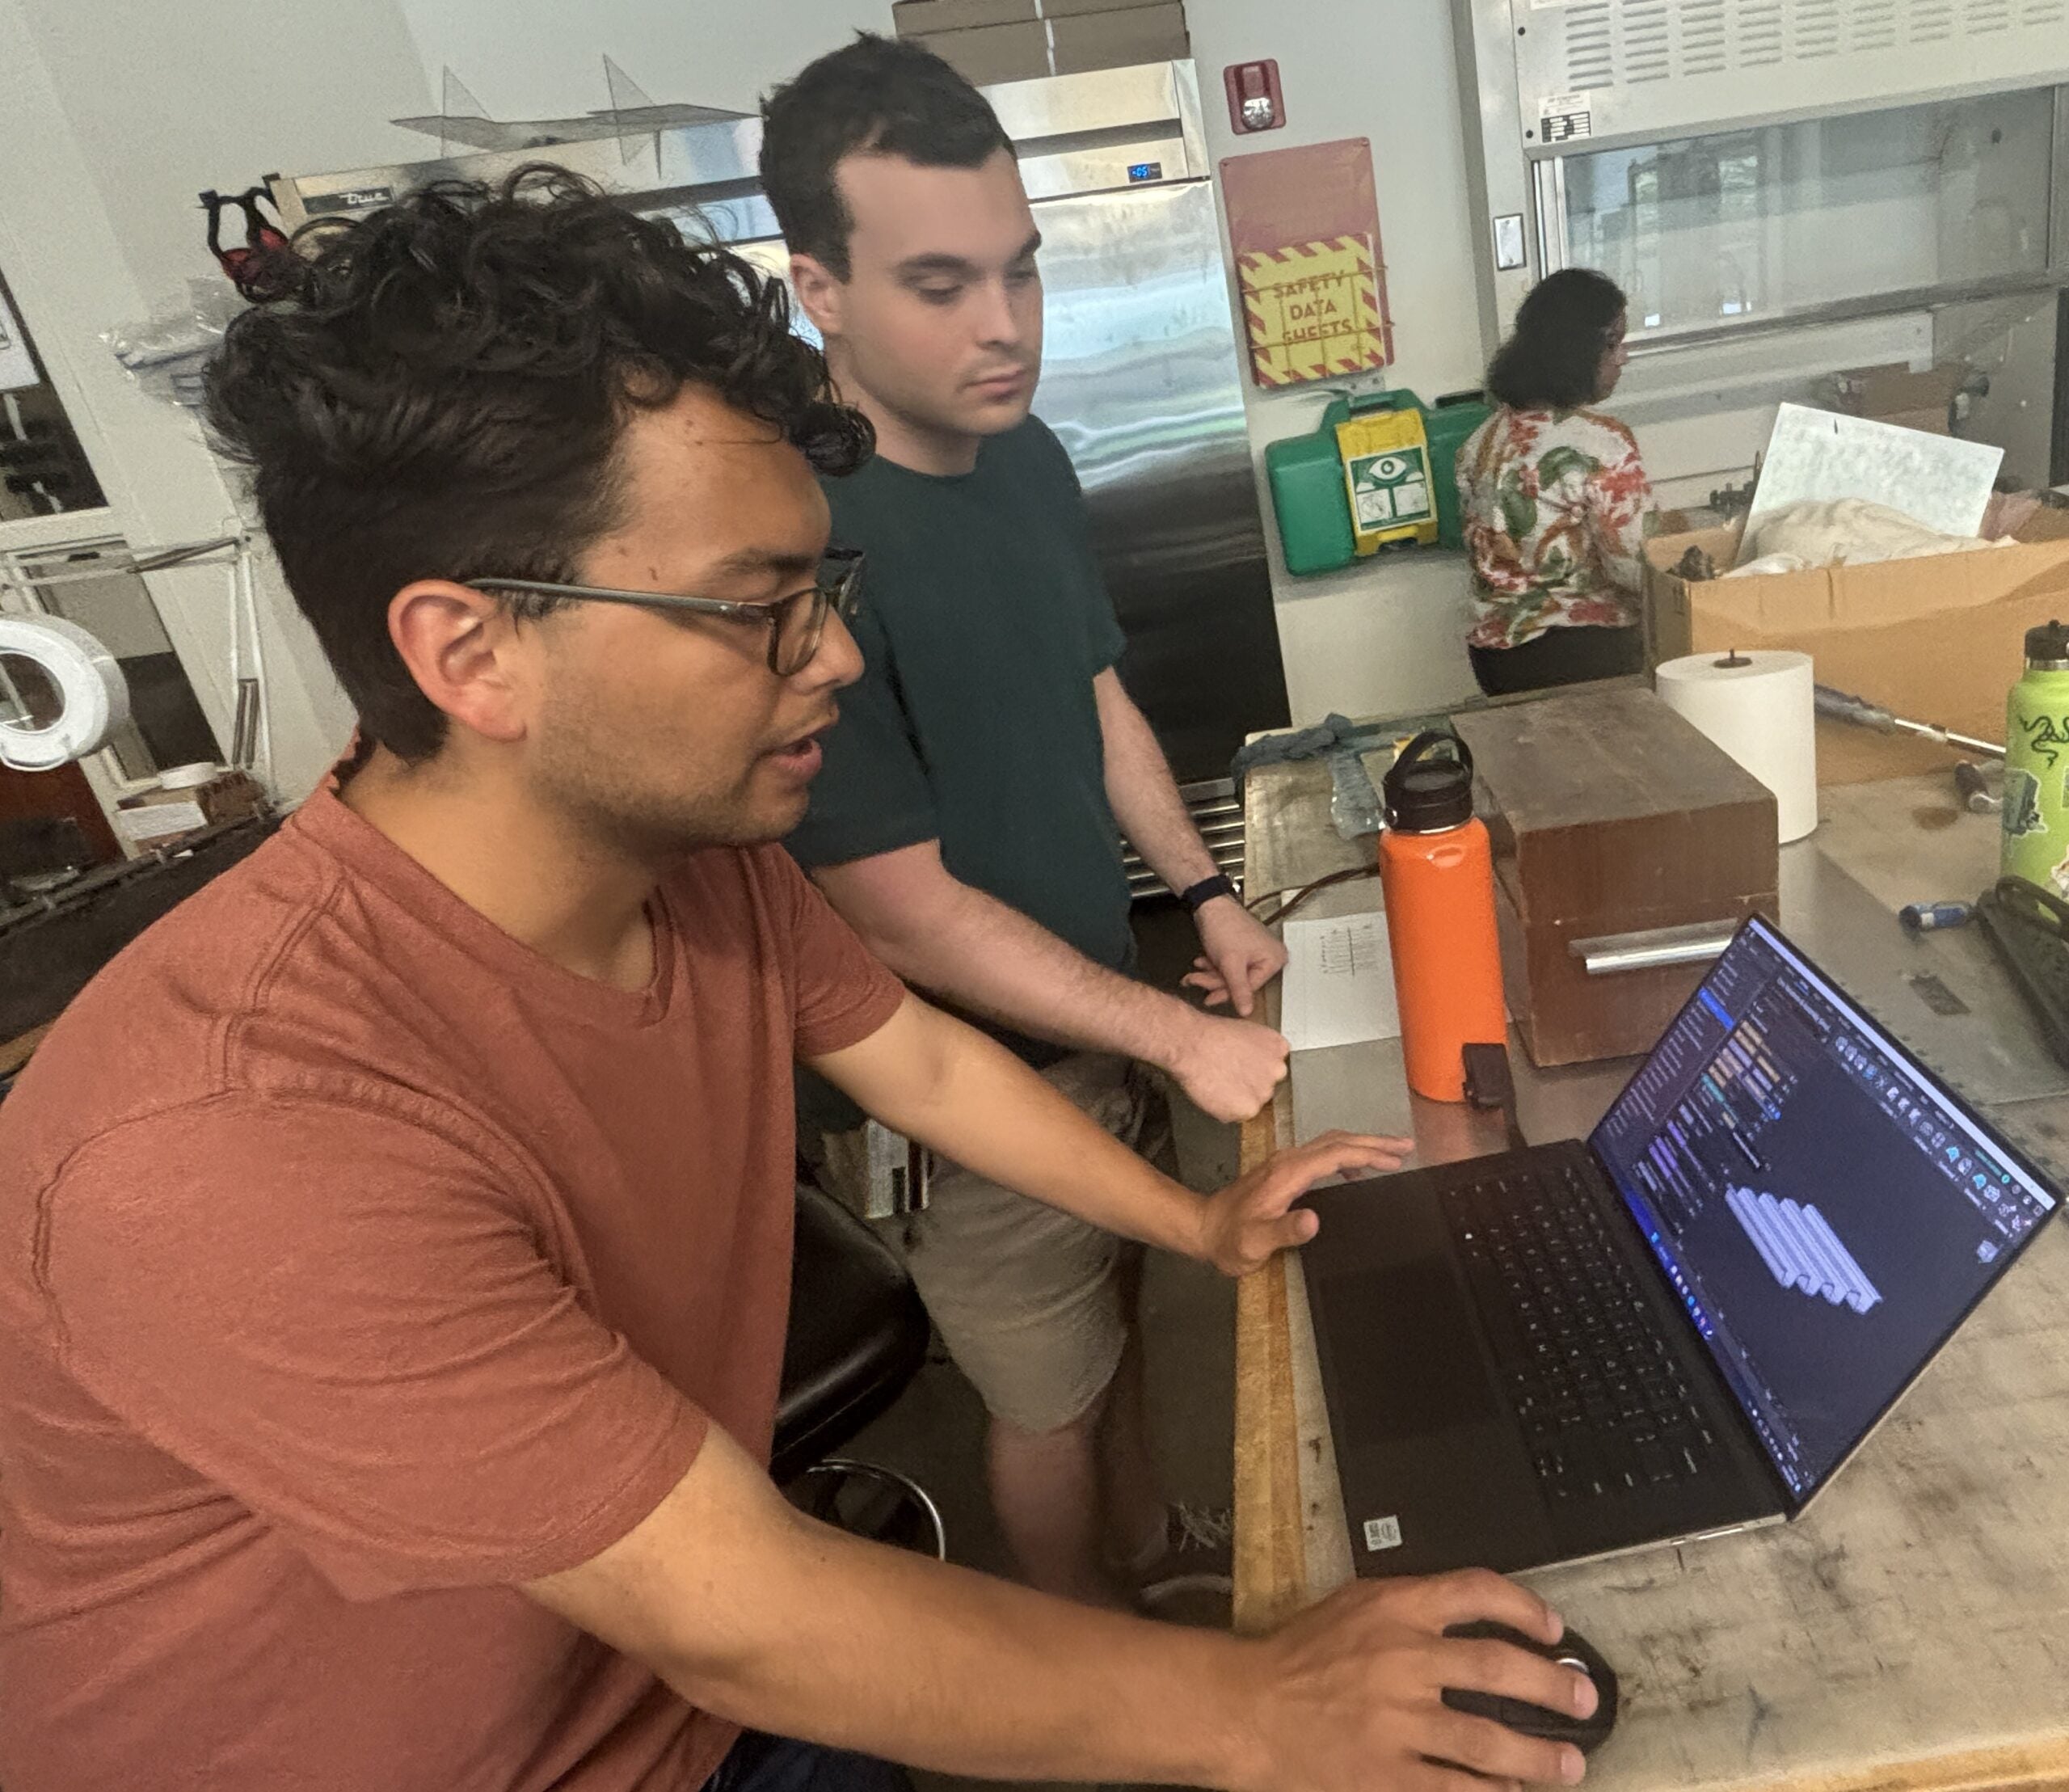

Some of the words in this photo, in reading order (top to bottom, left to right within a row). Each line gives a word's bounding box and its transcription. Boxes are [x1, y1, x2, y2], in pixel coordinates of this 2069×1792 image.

[1273, 270, 1344, 298] SAFETY
[1289, 299, 1337, 320] DATA
[1282, 318, 1352, 344] SHEETS
